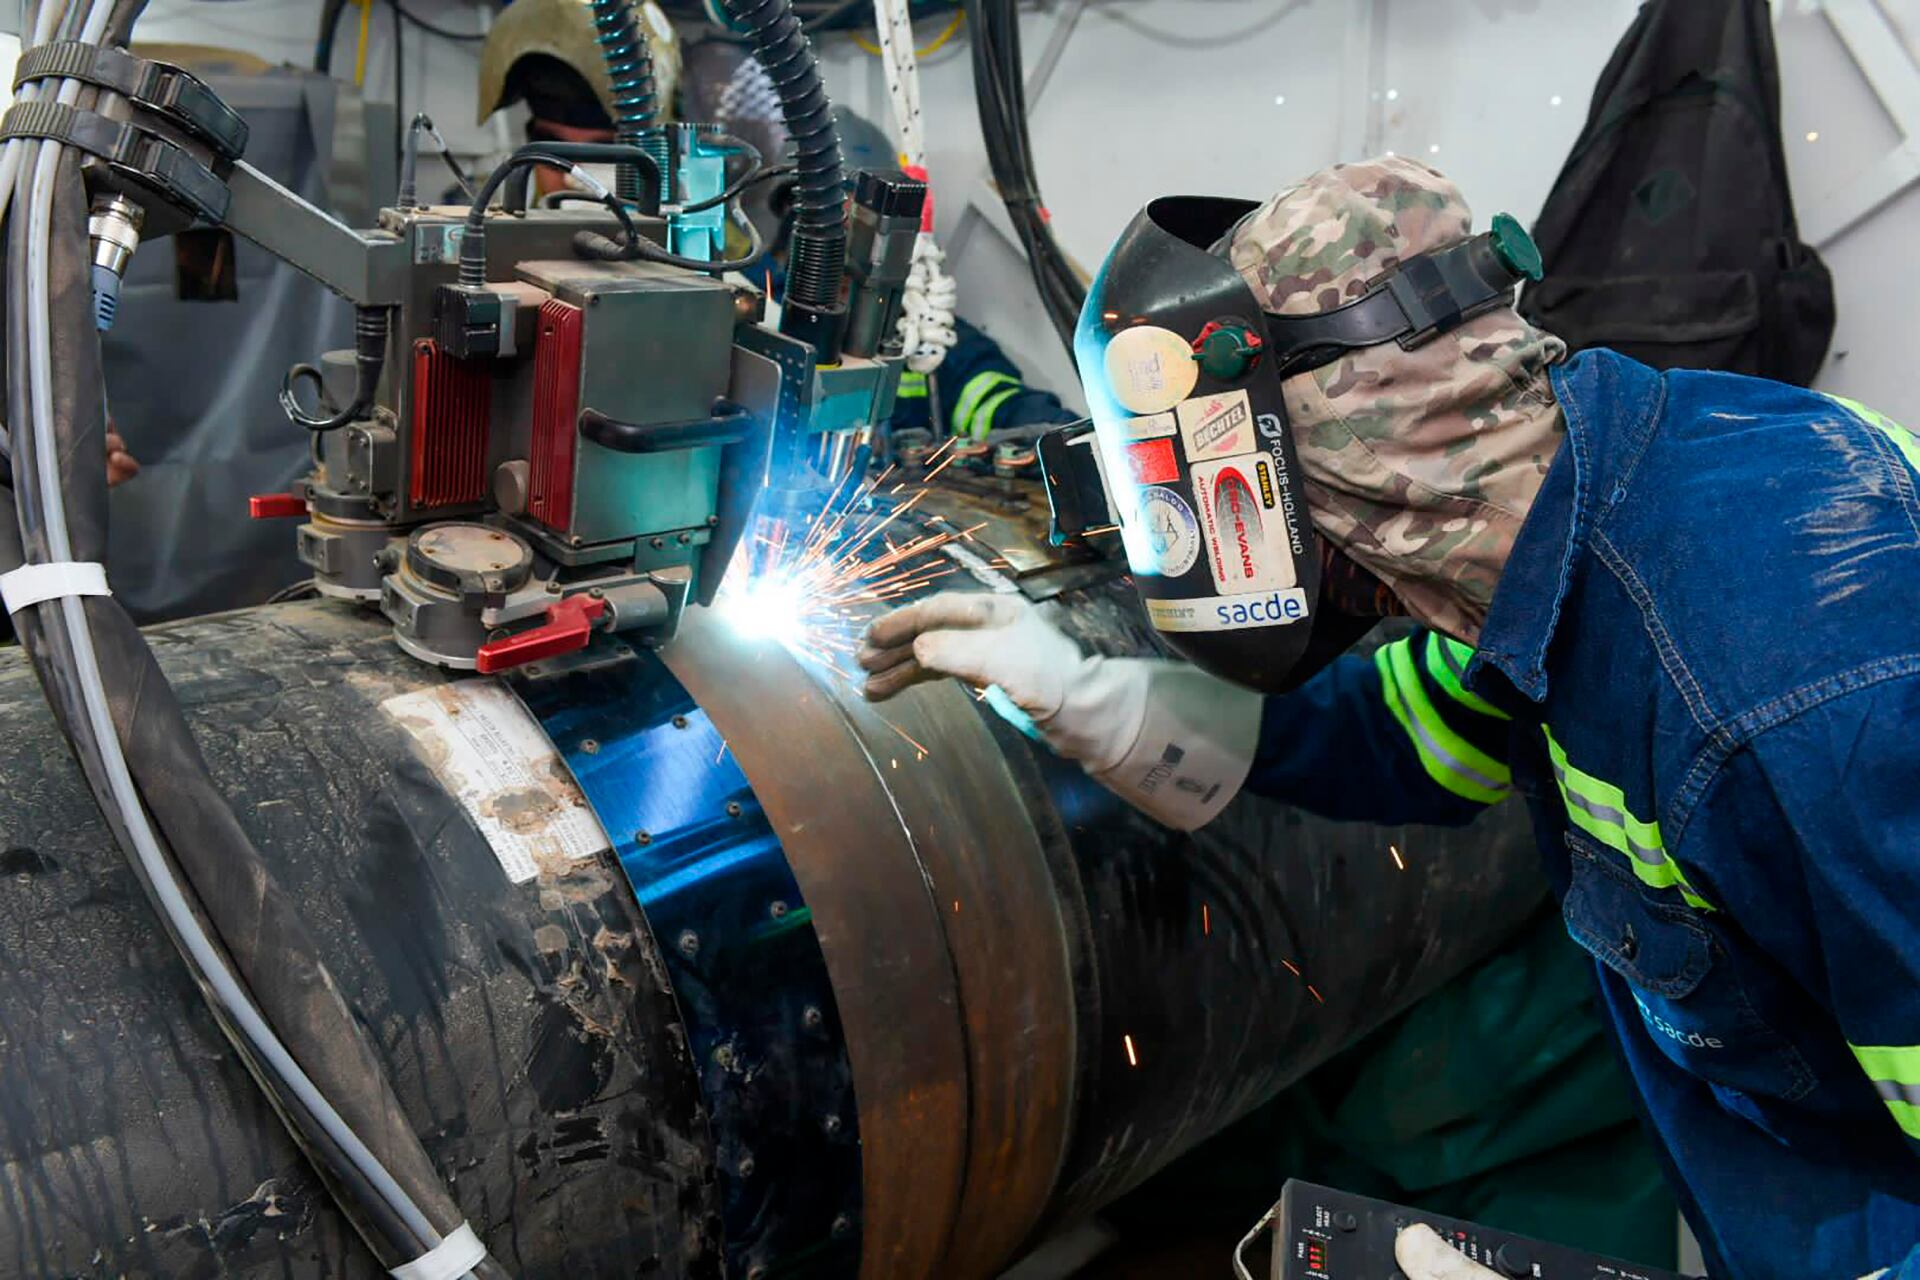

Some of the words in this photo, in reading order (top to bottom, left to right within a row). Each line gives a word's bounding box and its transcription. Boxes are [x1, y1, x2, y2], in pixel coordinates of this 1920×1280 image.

[1195, 405, 1245, 449] BECHTEL
[1257, 463, 1273, 507] STANLEY
[1270, 440, 1302, 555] FOCUS-HOLLAND
[1197, 475, 1217, 535] AUTOMATIC
[1212, 536, 1227, 582] WELDING
[1217, 593, 1301, 624] sacde
[1653, 1015, 1725, 1049] sacde
